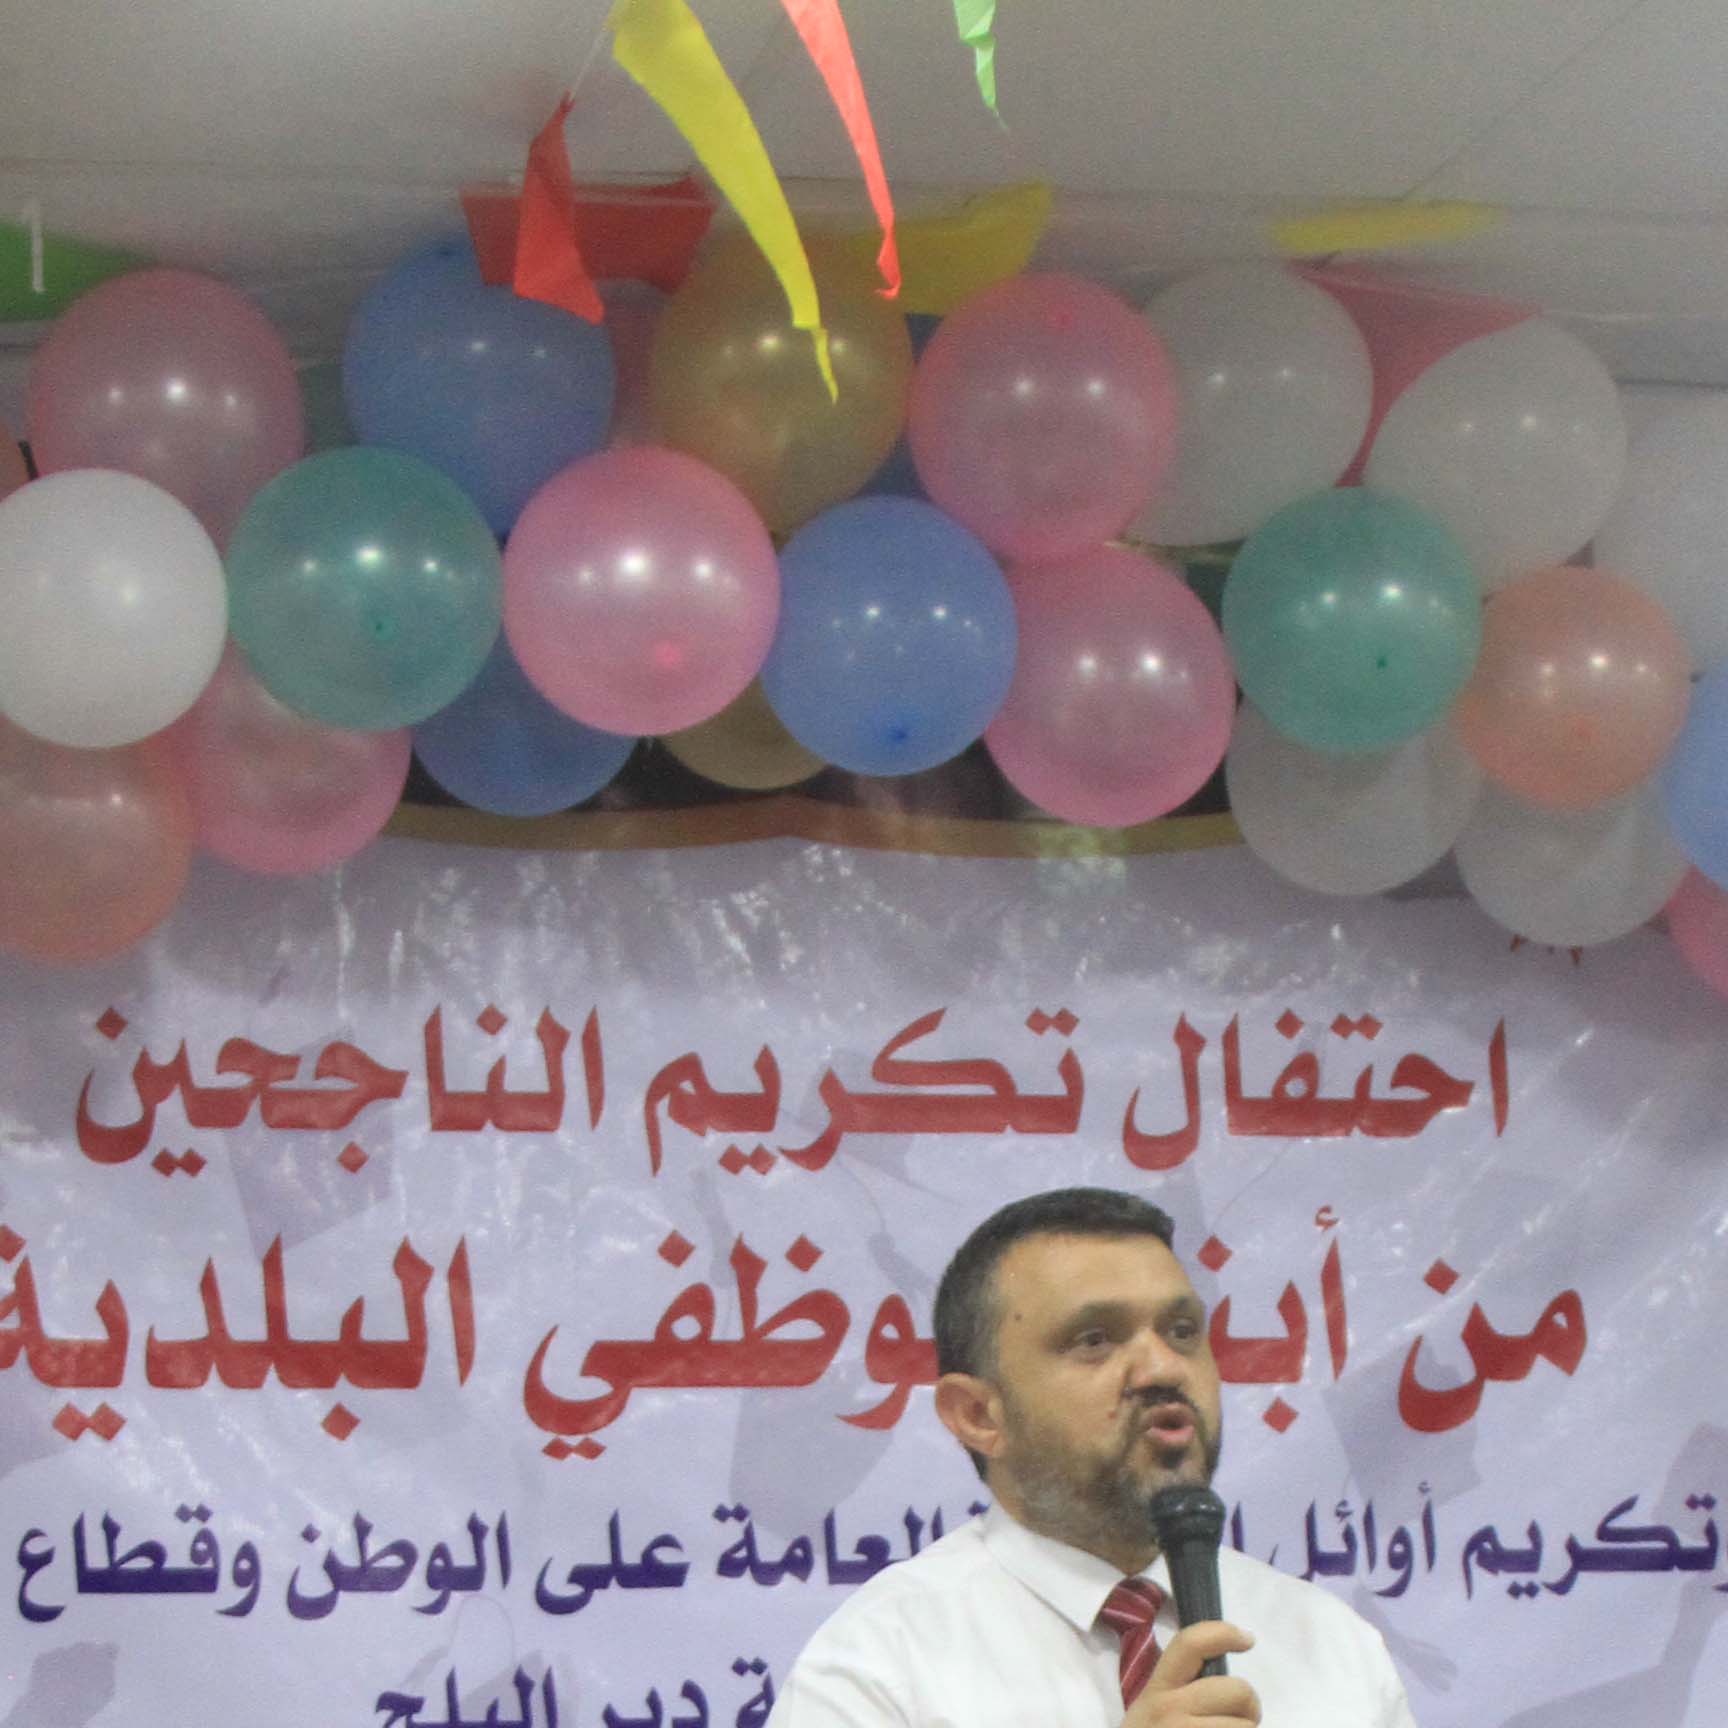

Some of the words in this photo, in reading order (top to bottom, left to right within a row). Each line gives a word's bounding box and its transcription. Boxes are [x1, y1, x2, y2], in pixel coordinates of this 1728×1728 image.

[76, 1003, 605, 1178] الناجحين
[643, 1007, 1085, 1178] تكريم
[1122, 1008, 1509, 1172] احتفال
[523, 1229, 937, 1460] وظفي
[1396, 1259, 1589, 1434] من
[18, 1503, 261, 1623] وقطاع
[286, 1508, 511, 1620] الوطن
[535, 1508, 690, 1616] على
[1298, 1480, 1436, 1598] أوائل
